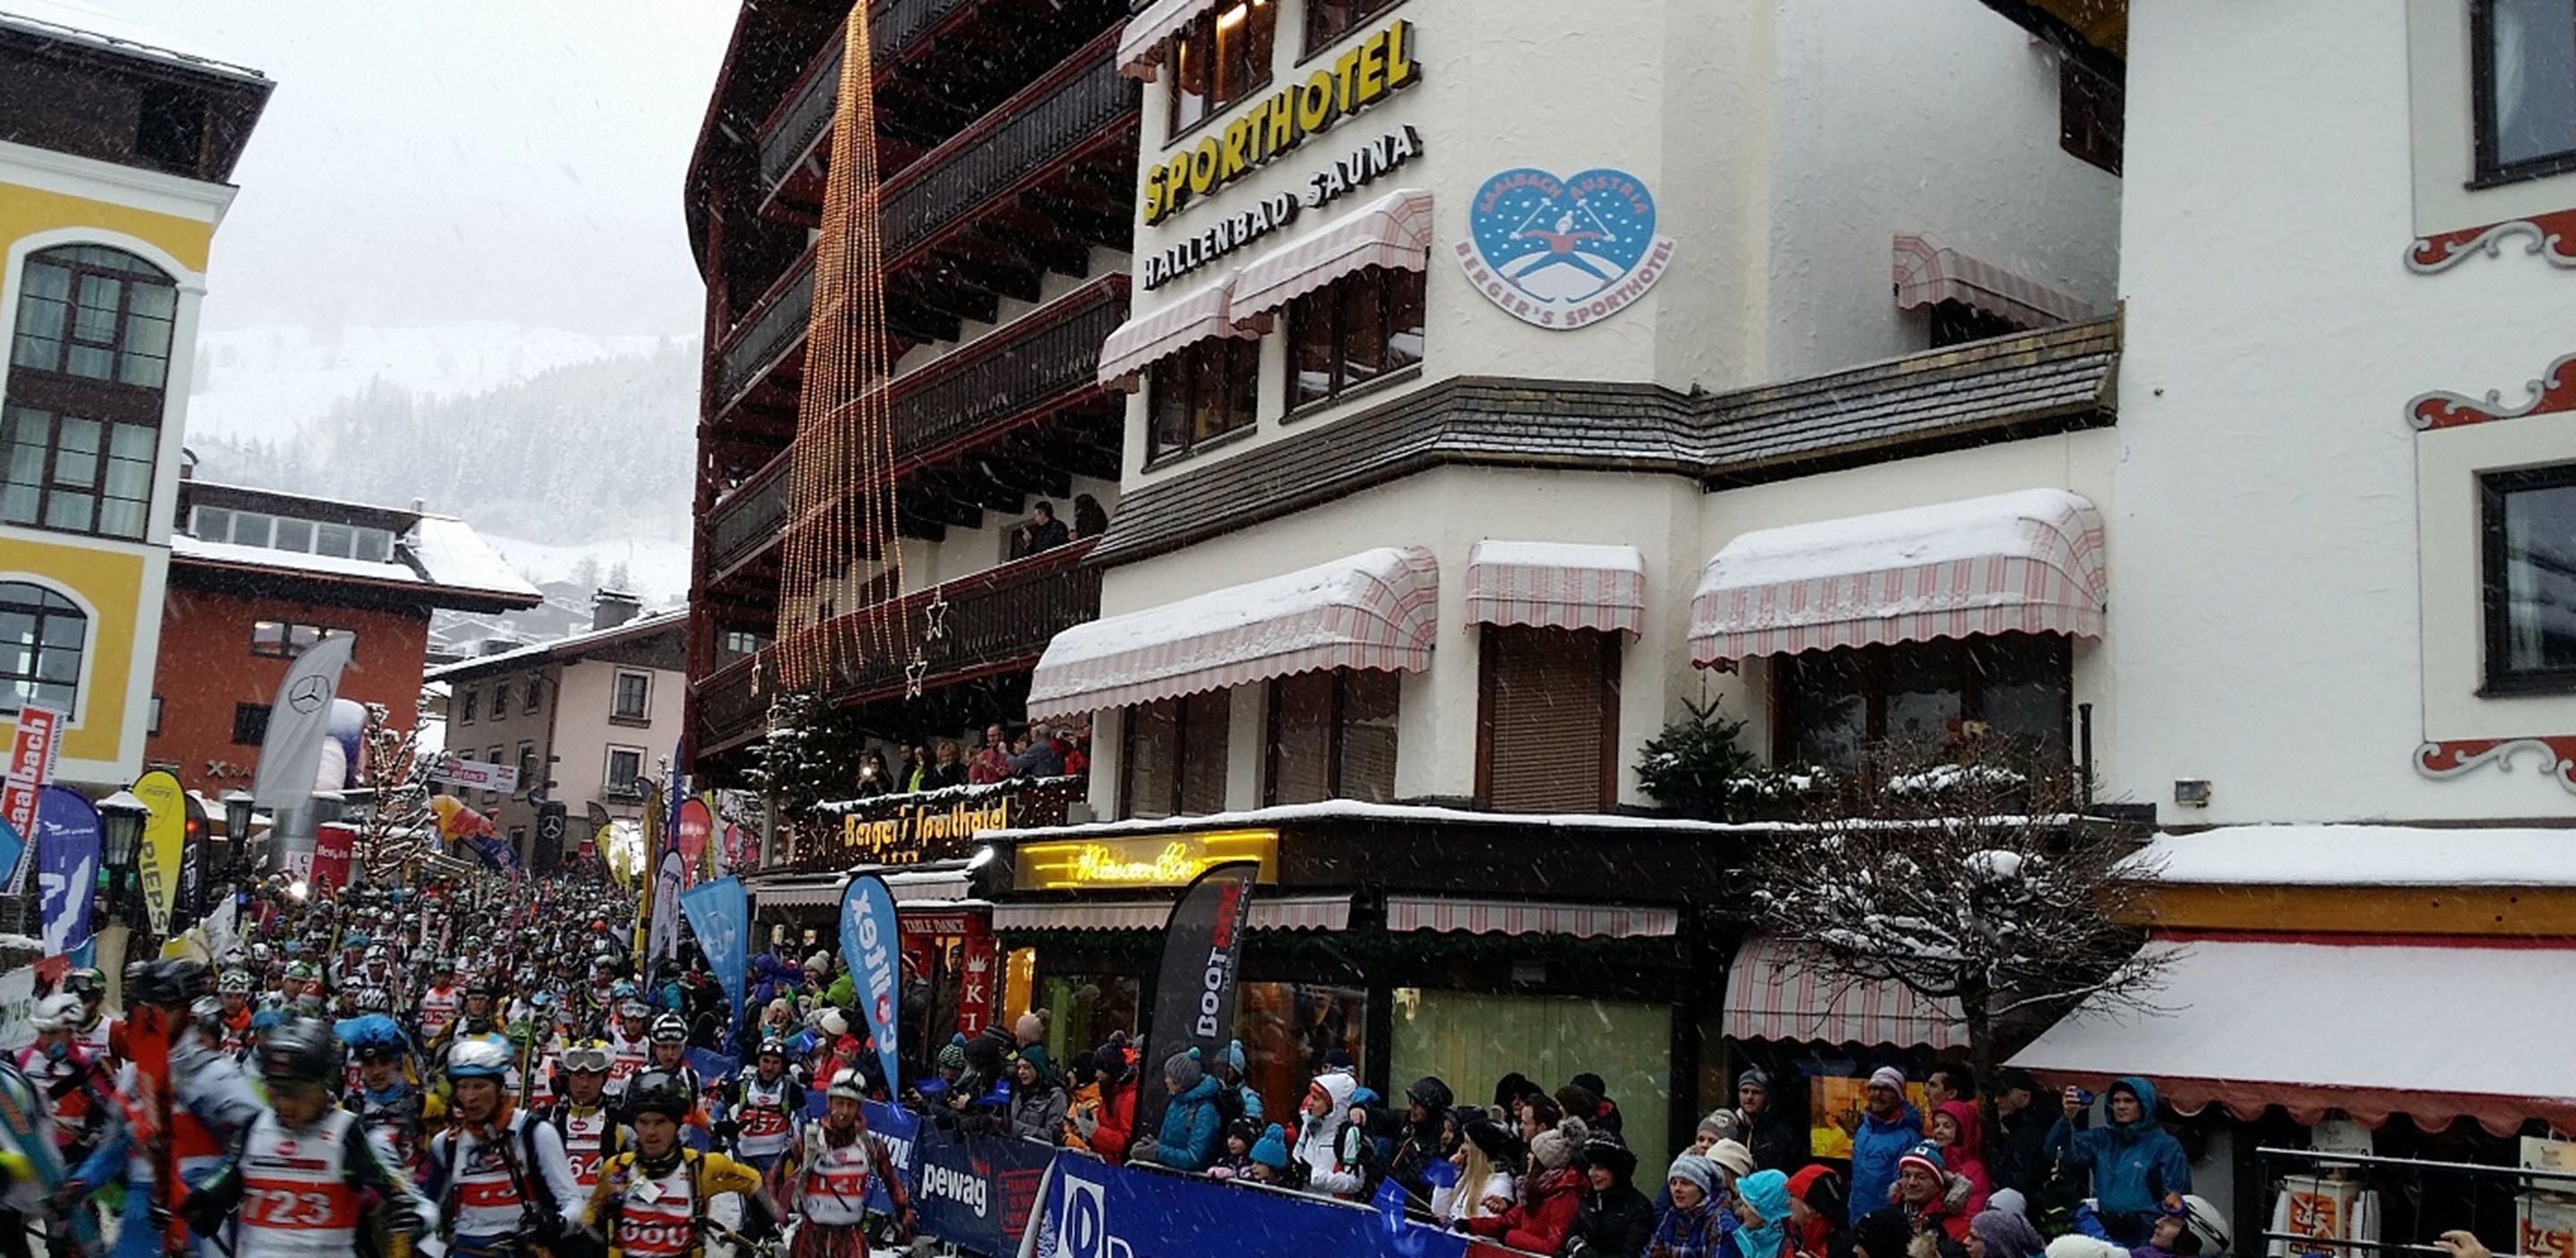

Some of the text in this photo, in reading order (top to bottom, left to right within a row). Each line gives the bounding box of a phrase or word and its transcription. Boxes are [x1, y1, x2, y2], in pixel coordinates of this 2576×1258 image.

[1144, 18, 1419, 225] SPORTHOTEL
[1143, 125, 1422, 290] HALLENBAD SAUNA
[1479, 173, 1648, 215] SAALBACH AUSTRIA
[1454, 239, 1674, 326] BERGER'S SPORTHOTEL
[14, 716, 47, 836] saalbach
[844, 795, 1007, 854] Berger's Sporthotel
[140, 841, 169, 935] PIEPS
[902, 917, 968, 933] TABLE DANCE
[242, 1186, 332, 1225] 723
[920, 1162, 987, 1218] pewag
